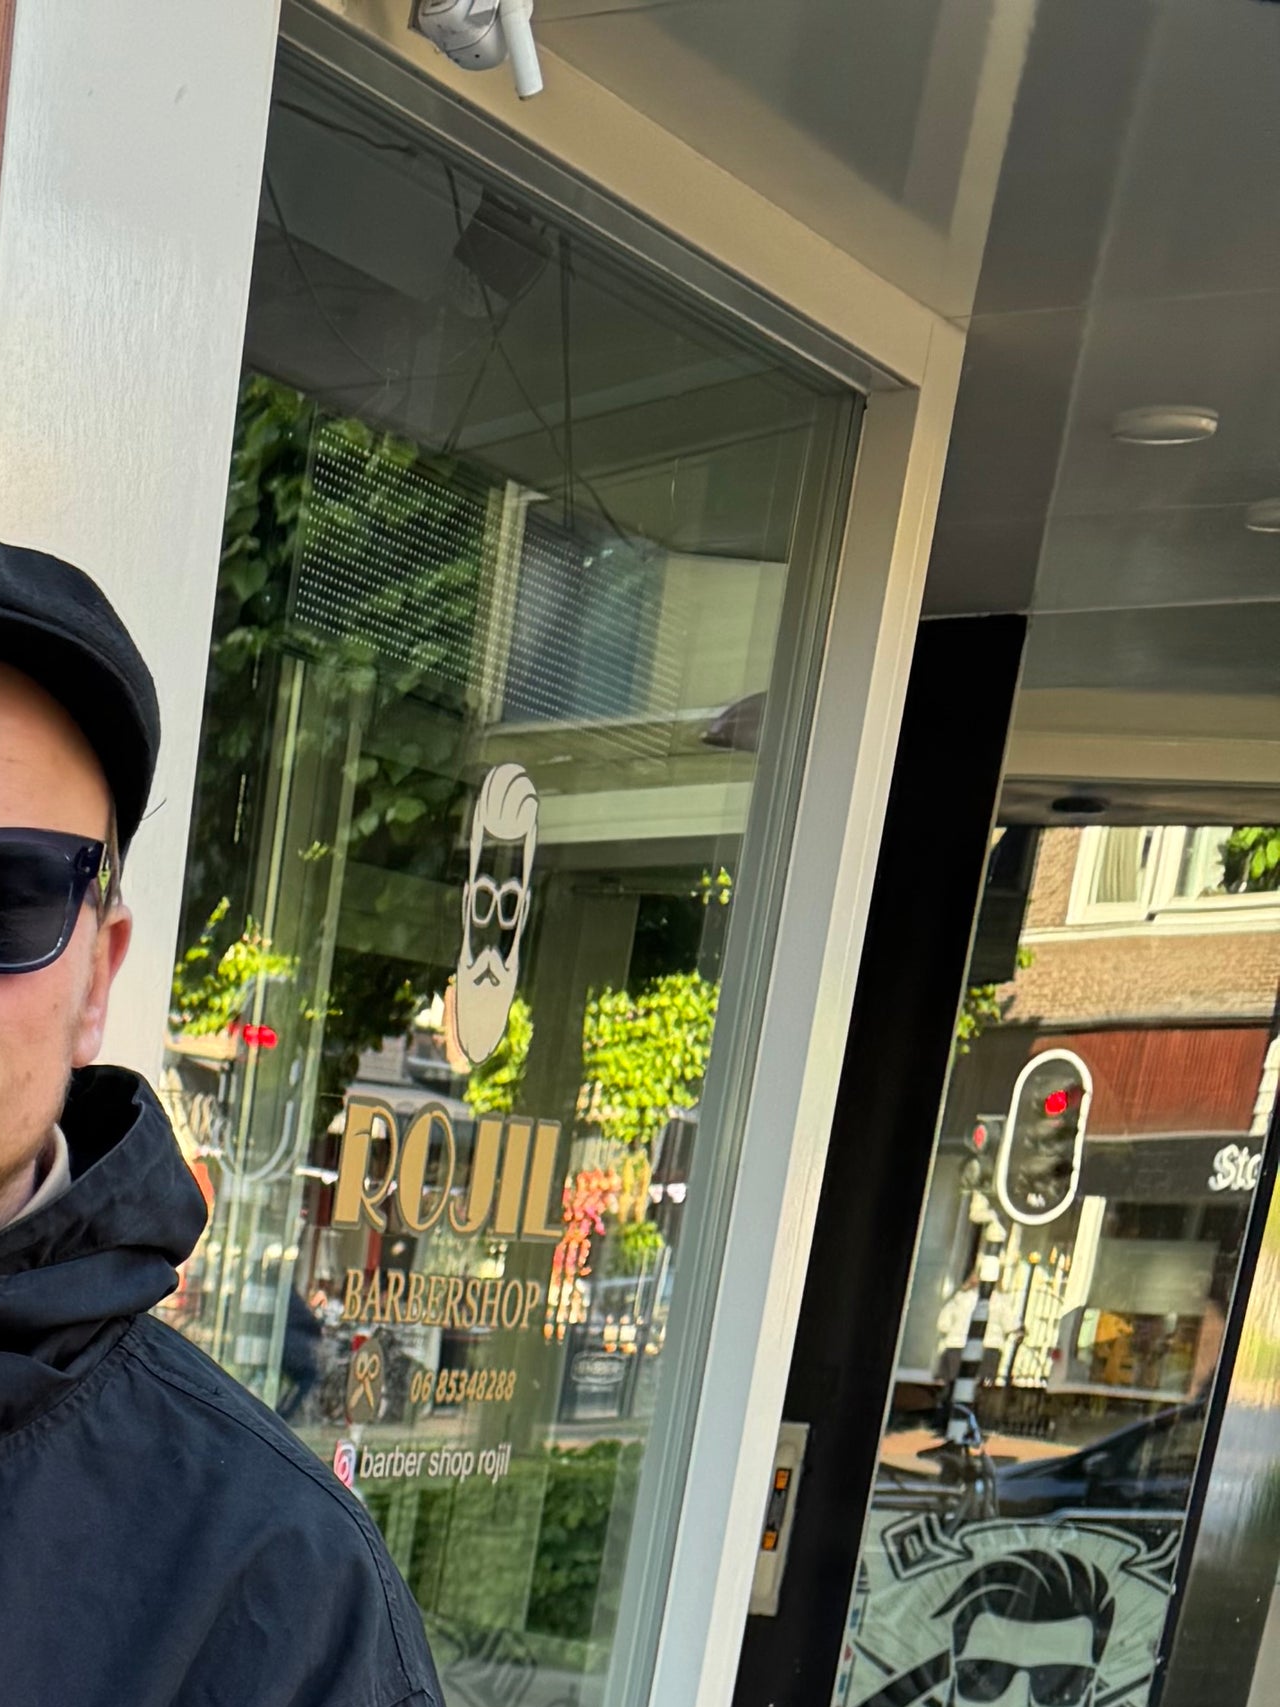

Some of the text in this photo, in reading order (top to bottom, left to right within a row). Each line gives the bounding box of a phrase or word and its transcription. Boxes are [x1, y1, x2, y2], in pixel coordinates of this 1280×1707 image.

[332, 1097, 565, 1241] ROJIL
[342, 1267, 542, 1331] BARBERSHOP
[409, 1369, 518, 1403] 06 85348288
[359, 1440, 513, 1485] barber shop rojil
